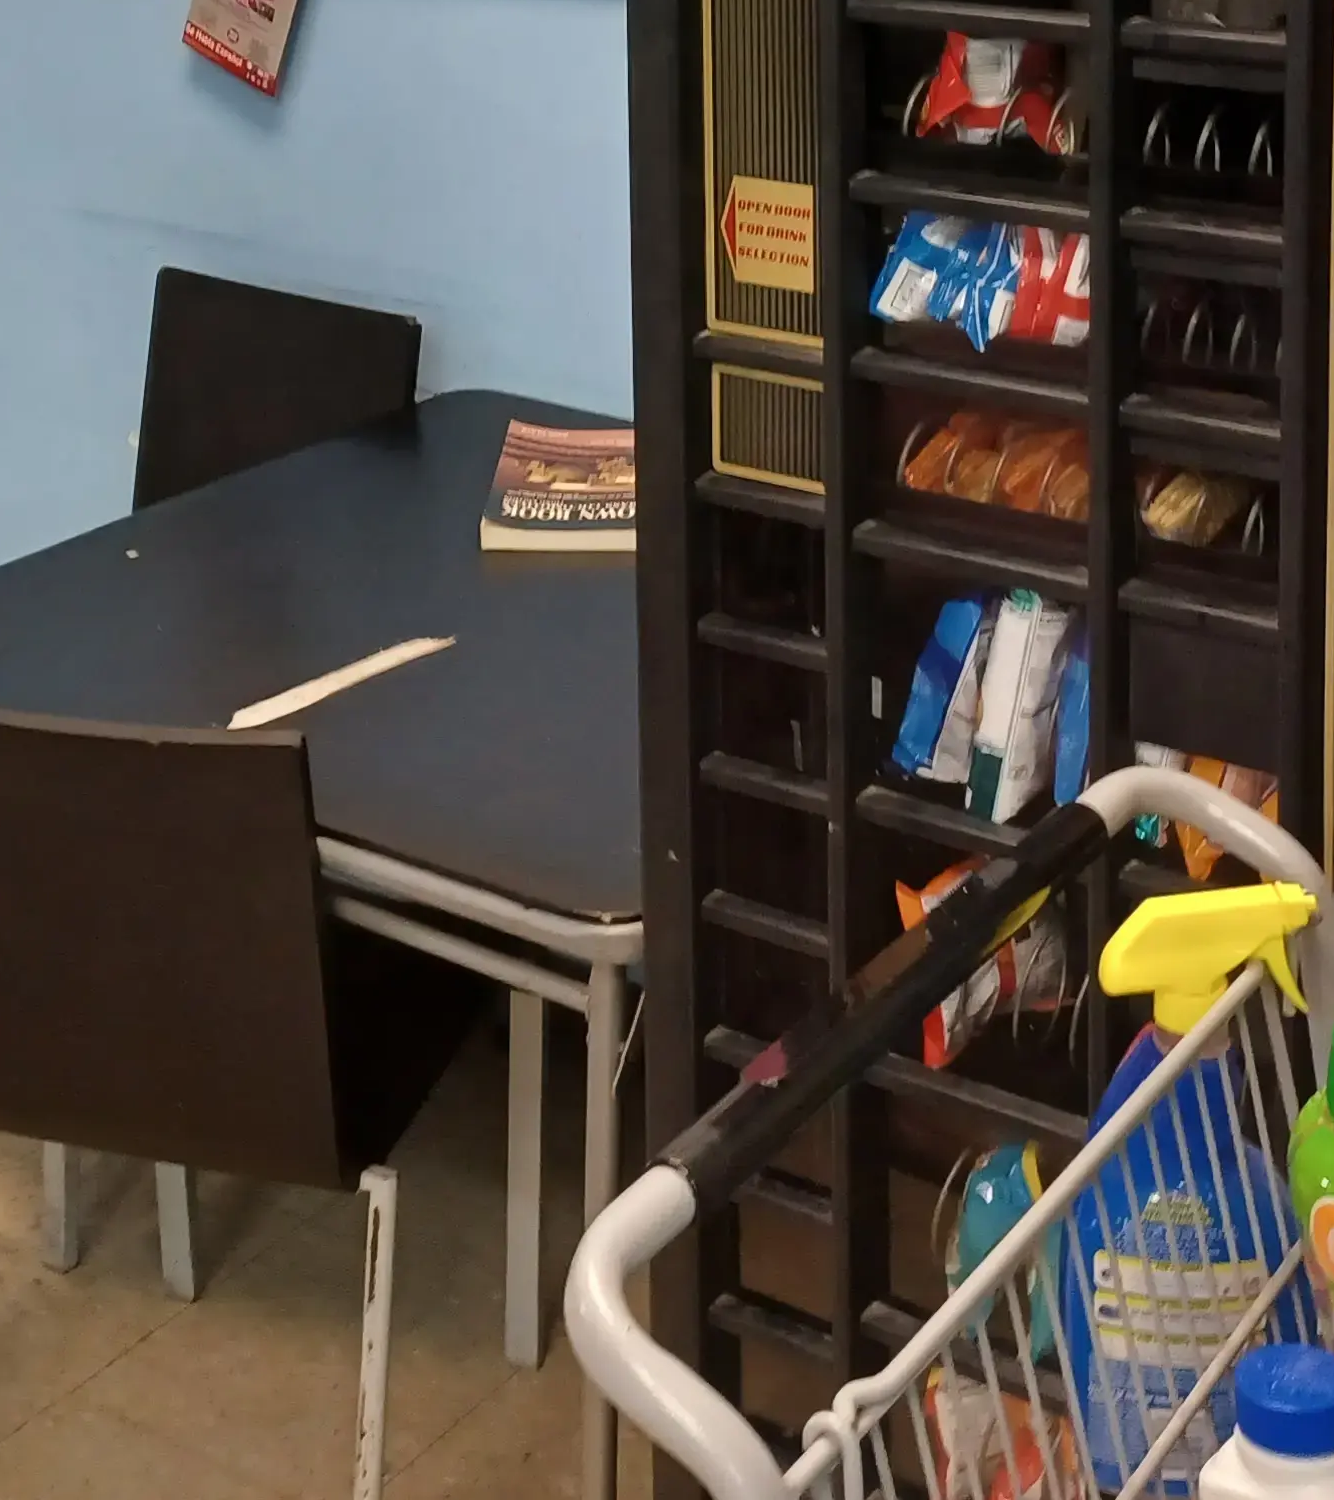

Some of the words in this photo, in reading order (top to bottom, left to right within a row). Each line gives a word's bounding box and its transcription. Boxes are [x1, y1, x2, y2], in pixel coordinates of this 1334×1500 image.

[738, 199, 773, 215] OPEN
[774, 203, 811, 220] DOOR
[738, 221, 764, 236] FOR
[766, 226, 807, 243] DRINK
[738, 245, 810, 268] SELECTION
